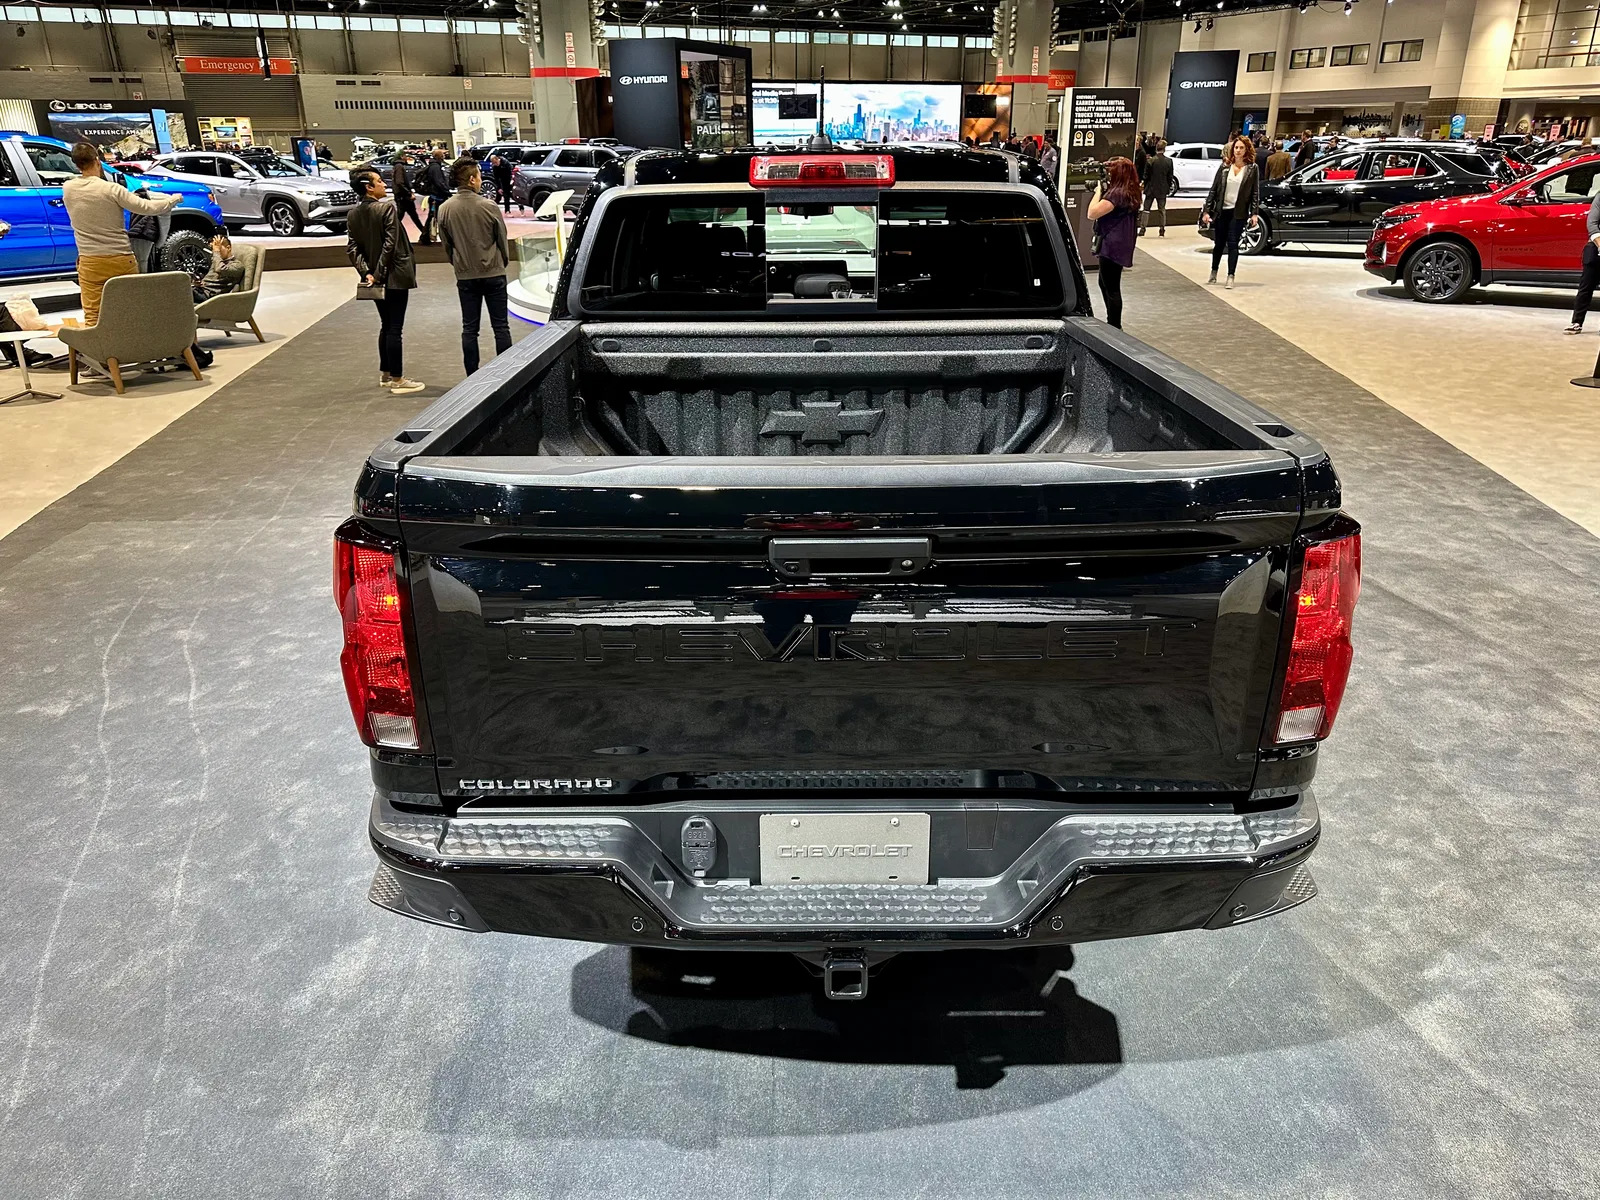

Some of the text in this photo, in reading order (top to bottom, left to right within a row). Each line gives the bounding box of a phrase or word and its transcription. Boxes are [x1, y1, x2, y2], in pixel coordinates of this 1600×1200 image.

[200, 60, 254, 72] Emergency
[634, 76, 668, 84] HYUNDAI
[505, 621, 1197, 662] CHEVROLET
[459, 778, 612, 790] COLORADO
[777, 844, 913, 858] CHEVROLET
